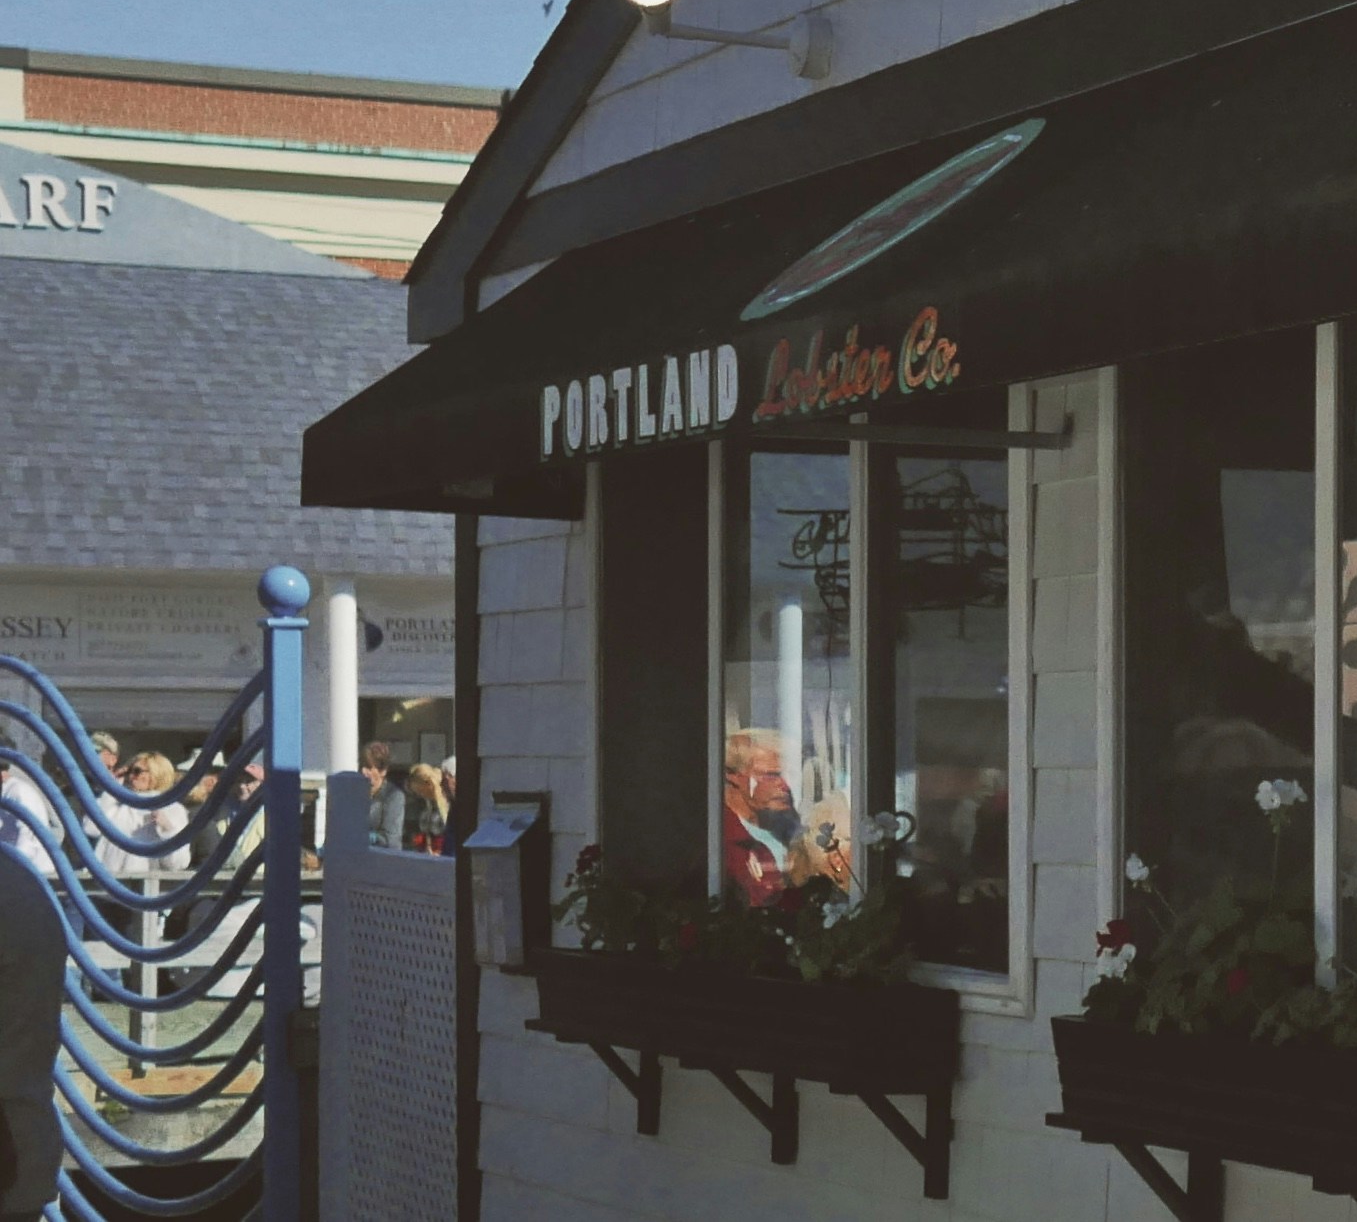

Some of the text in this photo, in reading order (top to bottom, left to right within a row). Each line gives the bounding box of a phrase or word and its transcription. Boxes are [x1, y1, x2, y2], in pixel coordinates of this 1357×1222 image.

[541, 343, 739, 458] PORTLAND
[753, 306, 960, 423] Lobster Co.
